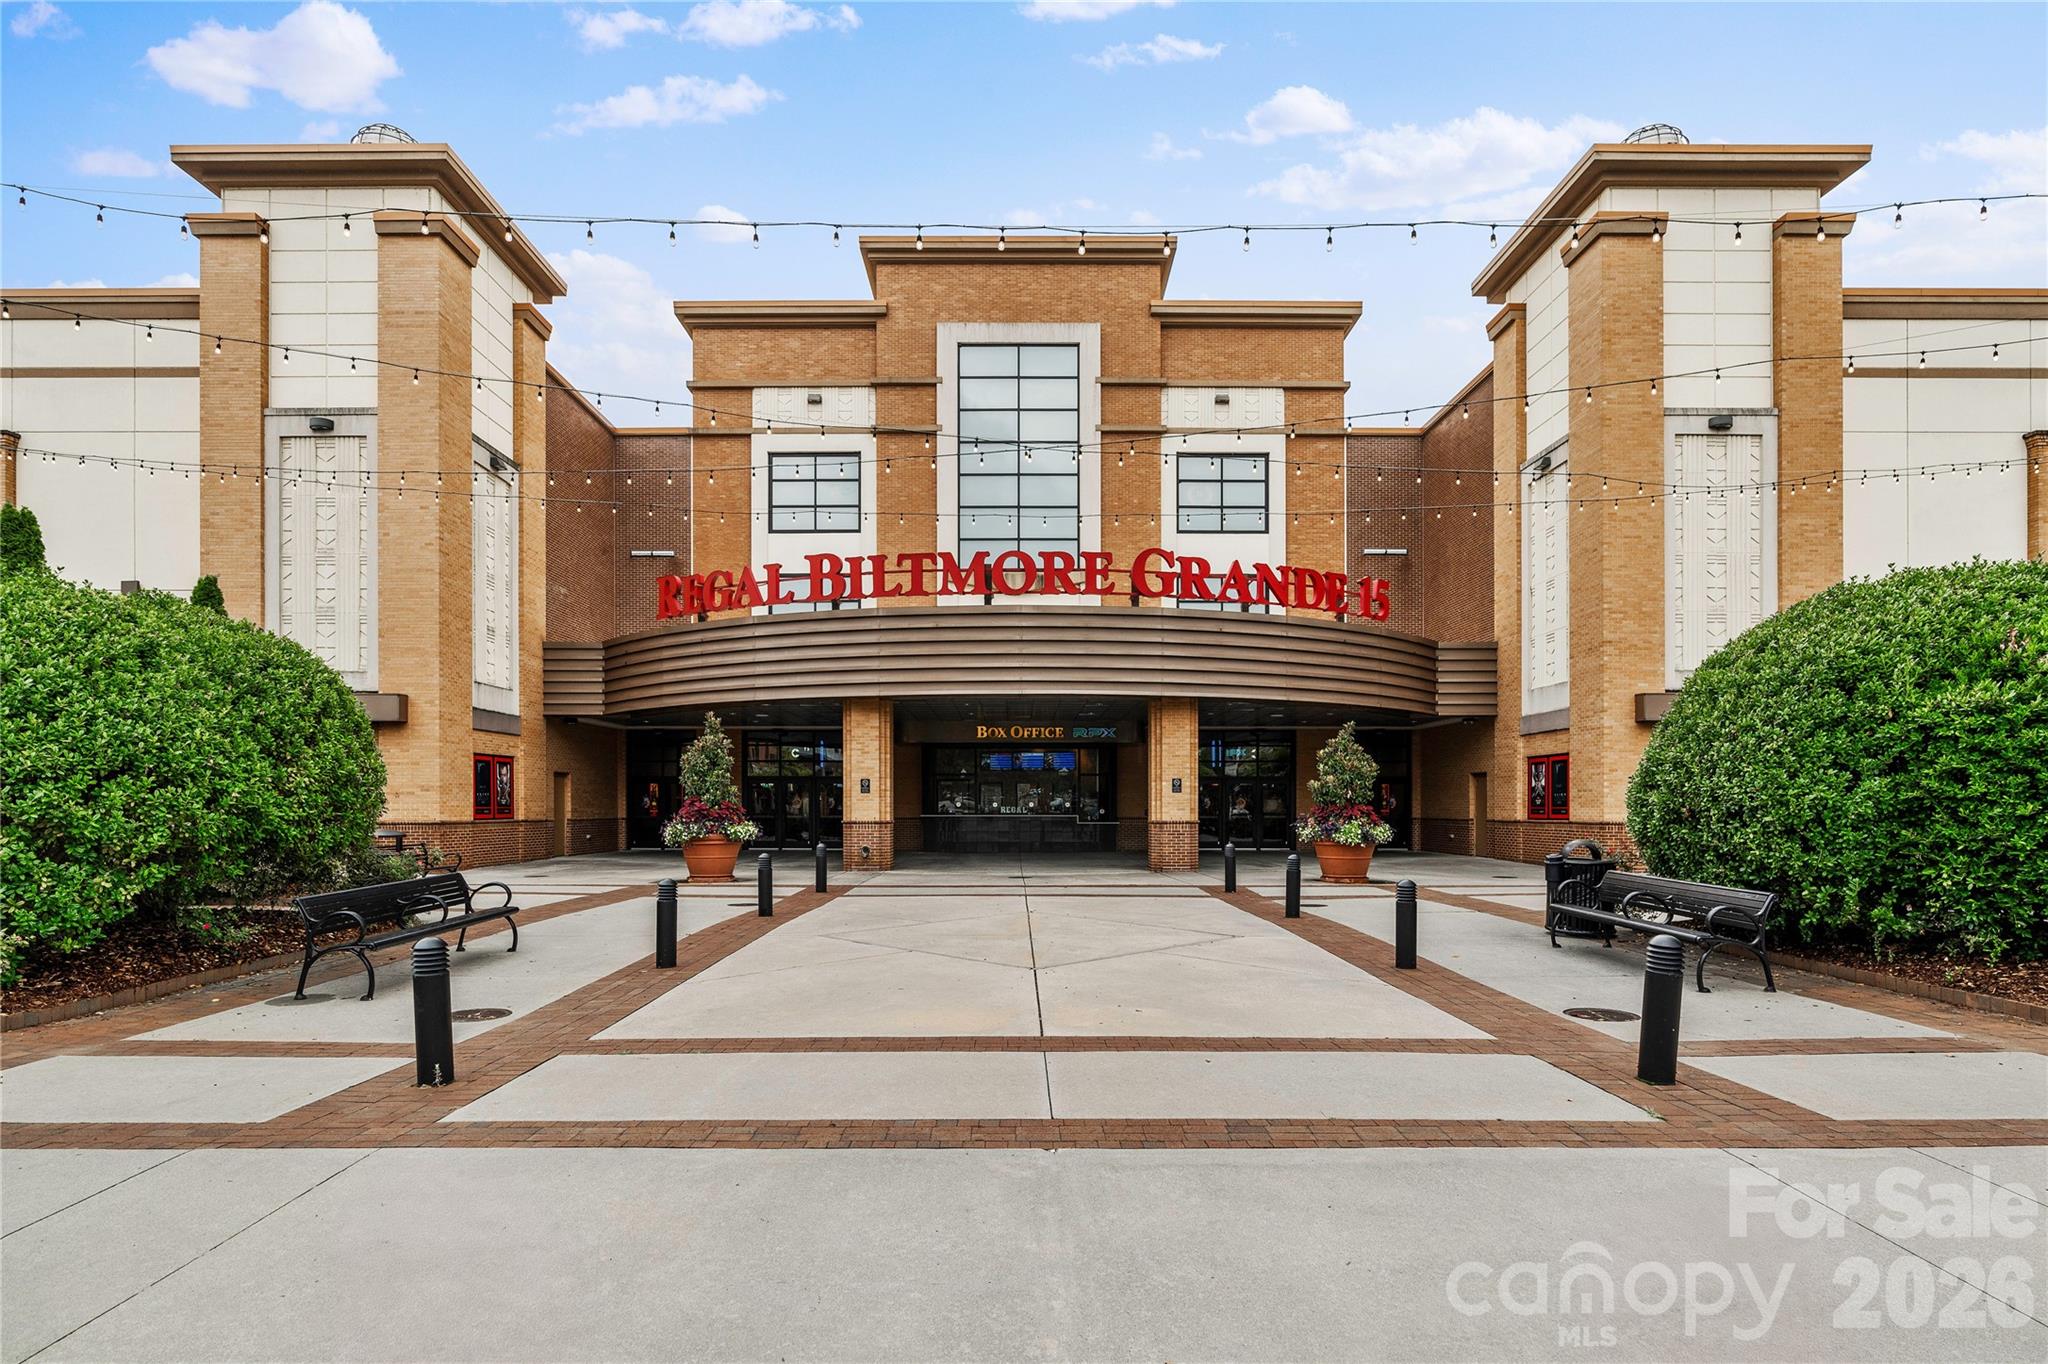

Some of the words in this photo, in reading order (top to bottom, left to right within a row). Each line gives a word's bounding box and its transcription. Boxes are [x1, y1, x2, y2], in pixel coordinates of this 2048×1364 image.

[656, 563, 795, 620] REGAL
[804, 550, 1116, 601] BILTMORE
[1131, 547, 1349, 613] GRANDE
[1357, 575, 1391, 622] 15
[976, 725, 1008, 738] BOX
[1010, 725, 1065, 738] OFFICE
[1072, 727, 1117, 738] RPX
